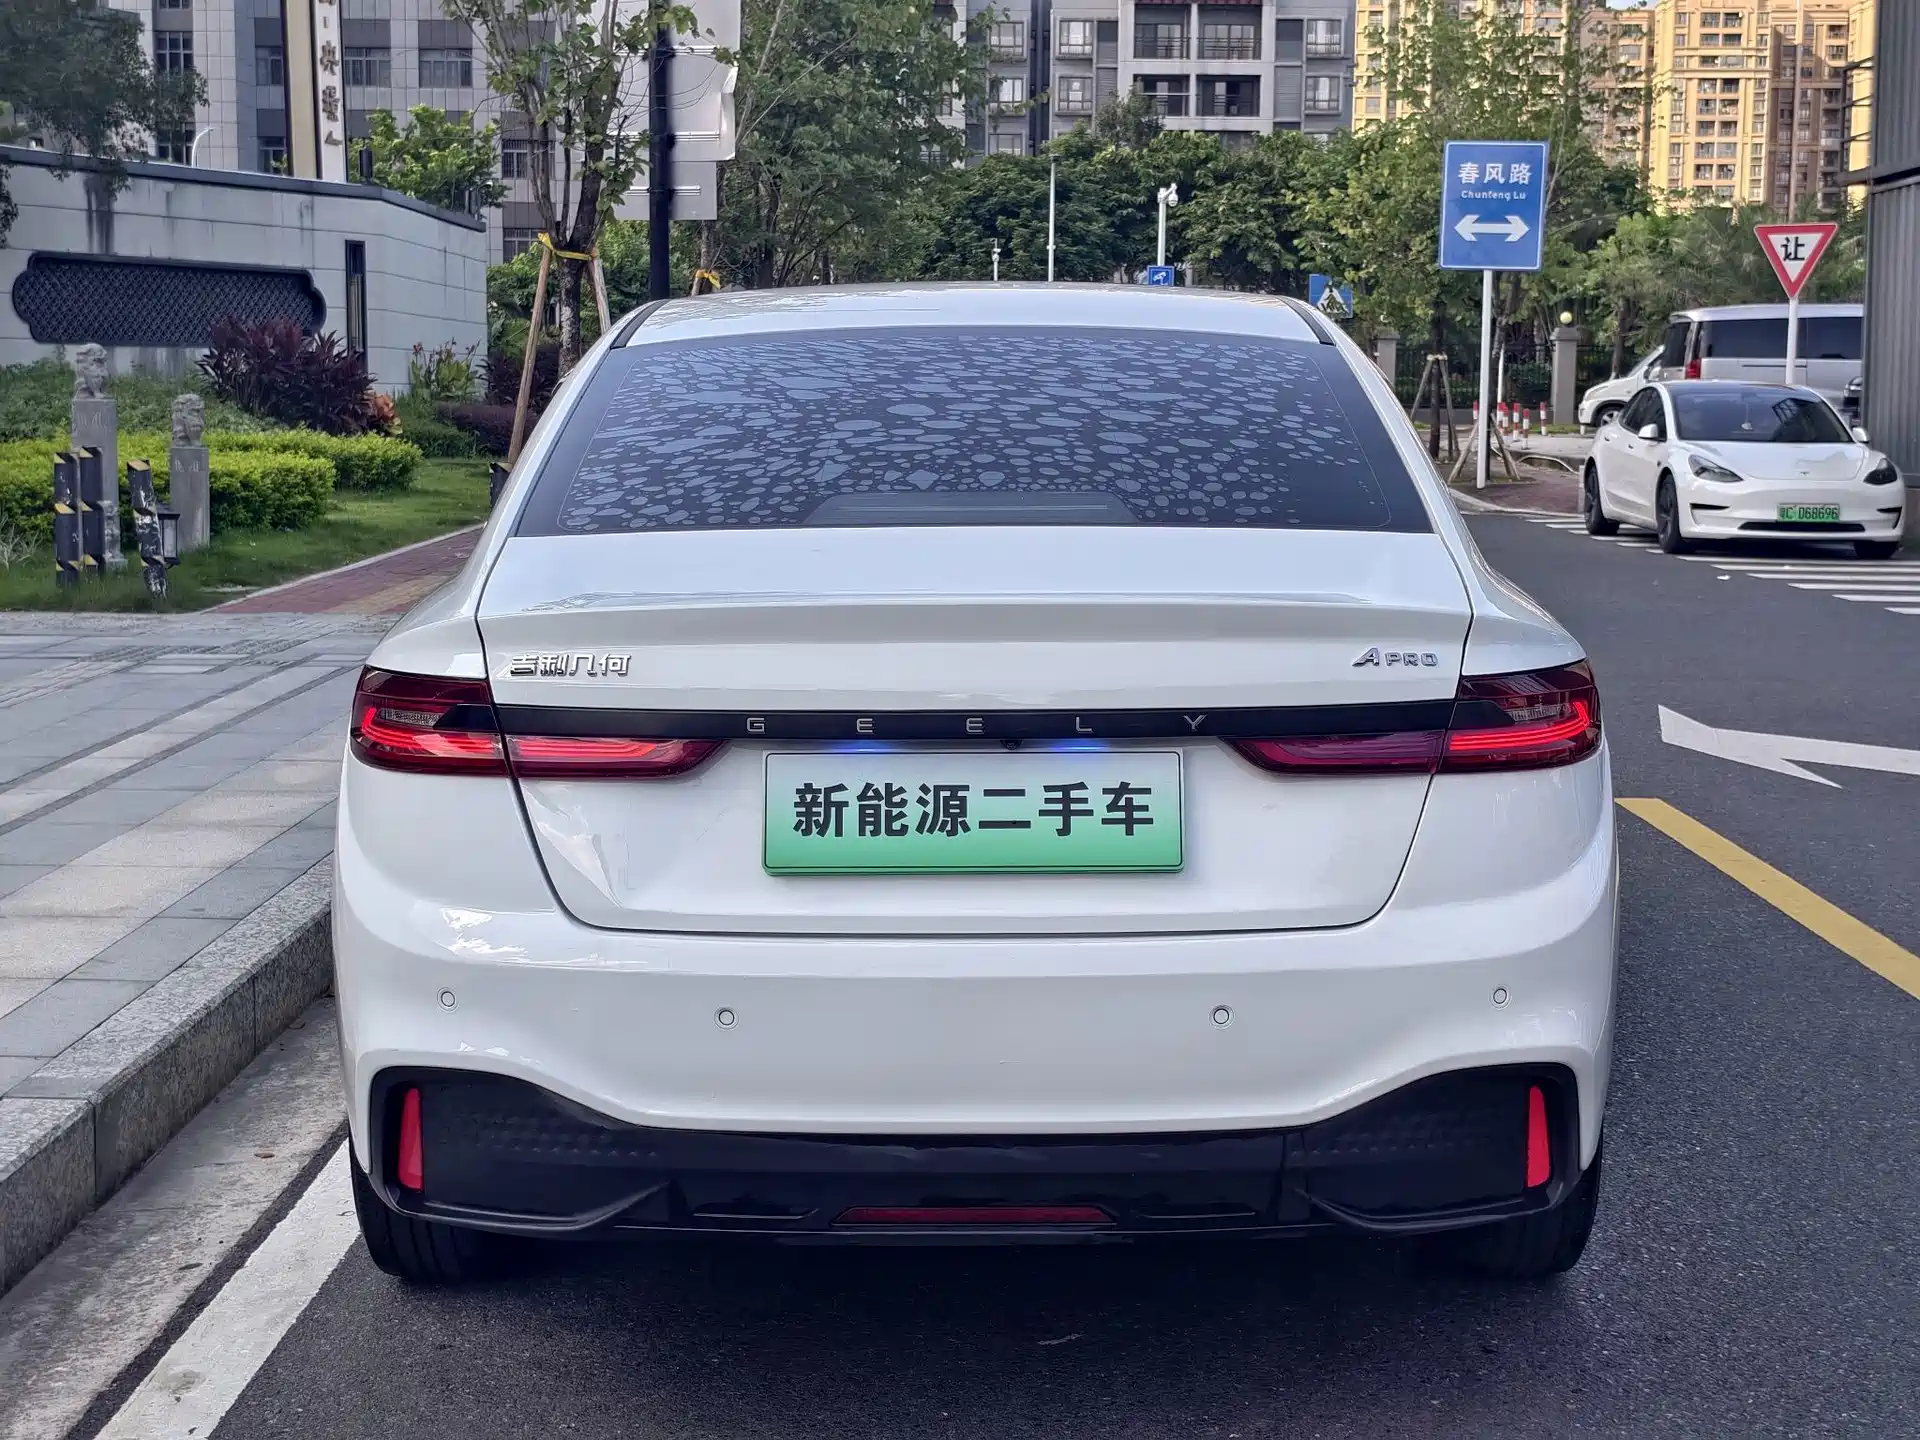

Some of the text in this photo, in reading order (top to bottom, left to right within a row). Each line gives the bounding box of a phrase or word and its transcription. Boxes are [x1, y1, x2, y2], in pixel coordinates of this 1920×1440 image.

[1458, 162, 1532, 185] 春风路
[1461, 190, 1527, 202] Chunfeng Lu
[1780, 236, 1806, 262] 让
[509, 653, 632, 677] 吉利几何
[1384, 652, 1439, 667] PRO
[746, 714, 1207, 735] GEELY
[793, 781, 1154, 838] 新能源二手车
